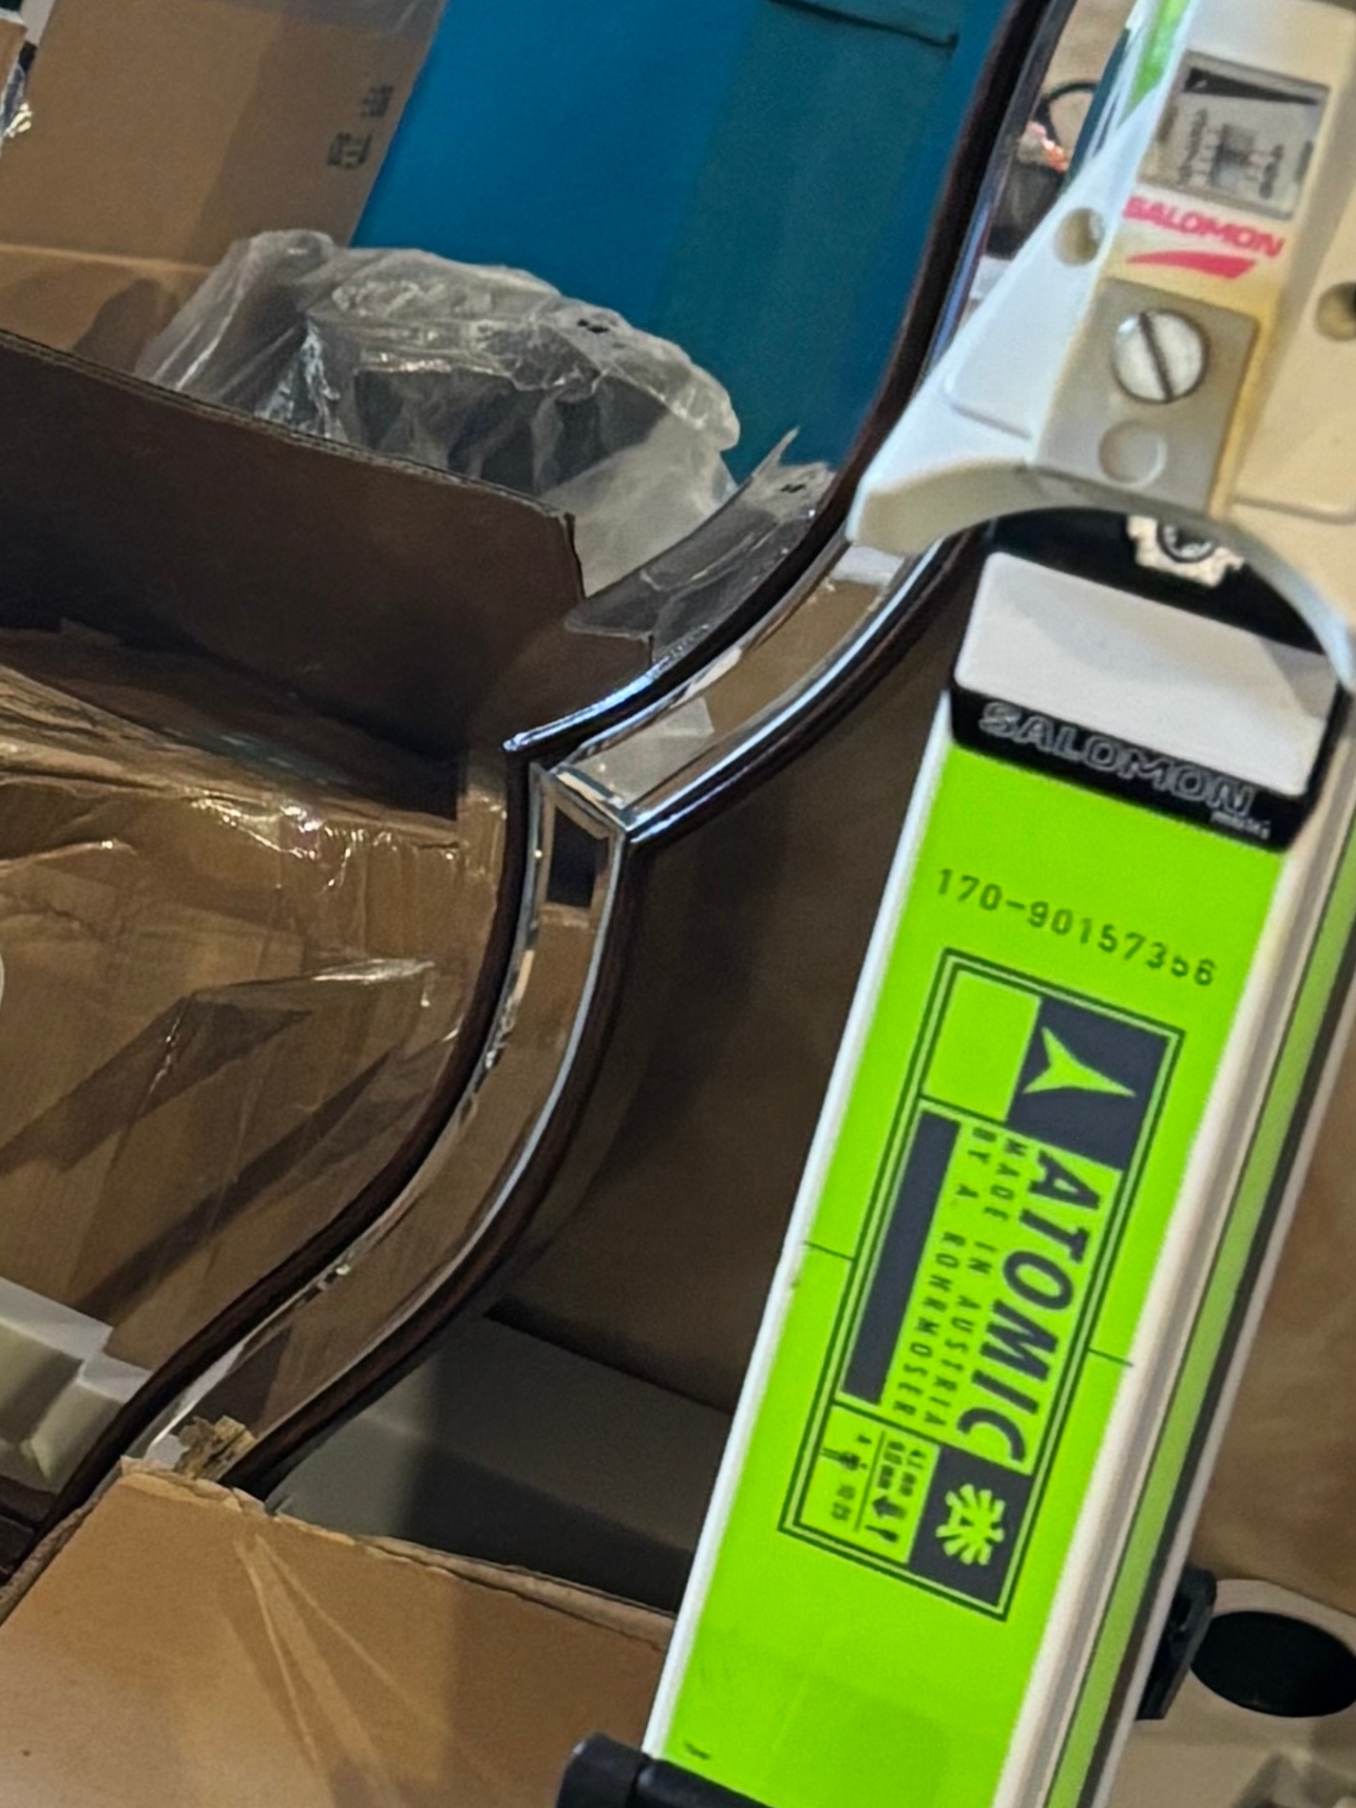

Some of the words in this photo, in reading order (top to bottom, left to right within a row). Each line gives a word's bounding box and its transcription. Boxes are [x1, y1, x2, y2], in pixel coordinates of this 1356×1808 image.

[1122, 195, 1285, 258] SALOMON
[978, 701, 1255, 817] SALOMON
[967, 1125, 994, 1167] BY
[984, 1134, 1026, 1224] MADE
[956, 1151, 1102, 1463] ATOMIC
[966, 1238, 997, 1277] IN
[890, 1227, 964, 1422] ROHRMOSER
[924, 1292, 979, 1431] AUSTRIA
